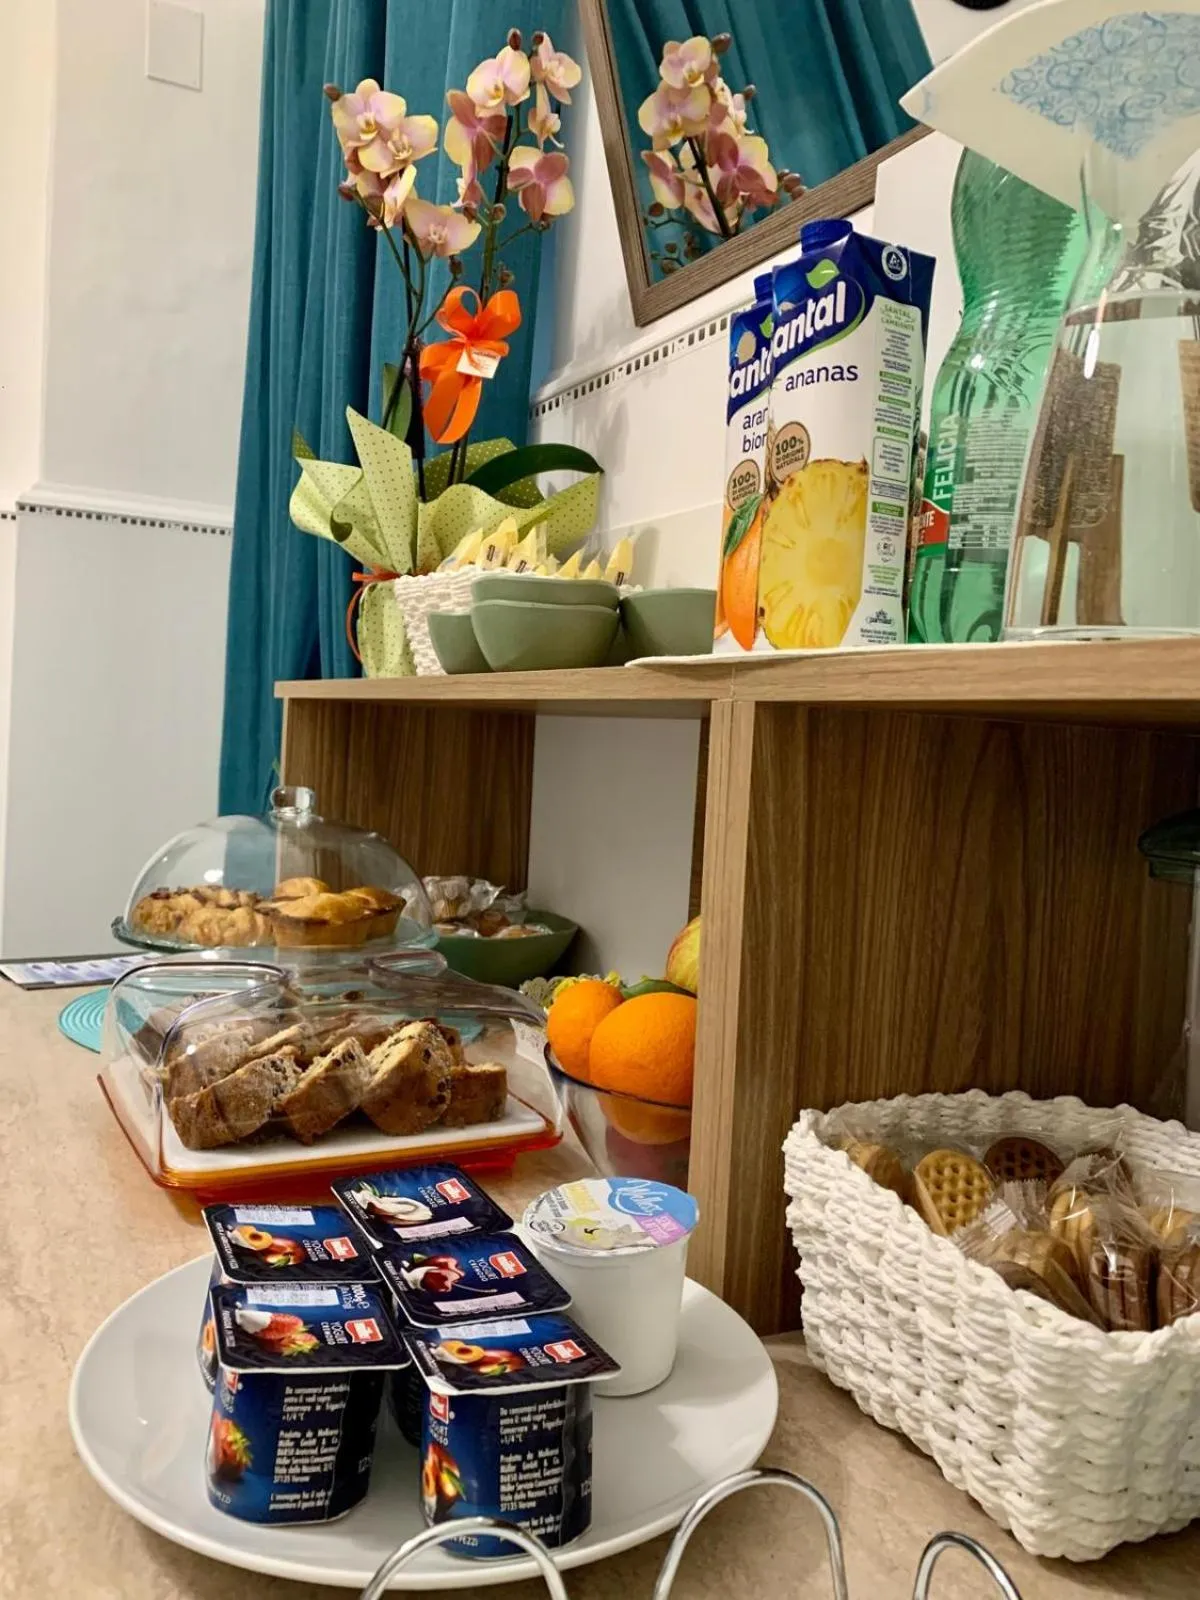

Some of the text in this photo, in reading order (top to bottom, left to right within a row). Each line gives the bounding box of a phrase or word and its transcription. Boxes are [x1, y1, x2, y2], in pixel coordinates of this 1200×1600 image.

[785, 365, 858, 392] ananas
[776, 437, 804, 455] 100%
[932, 415, 960, 498] FELICIA
[320, 1322, 336, 1346] CREMOSO
[331, 1321, 348, 1344] YOGURT
